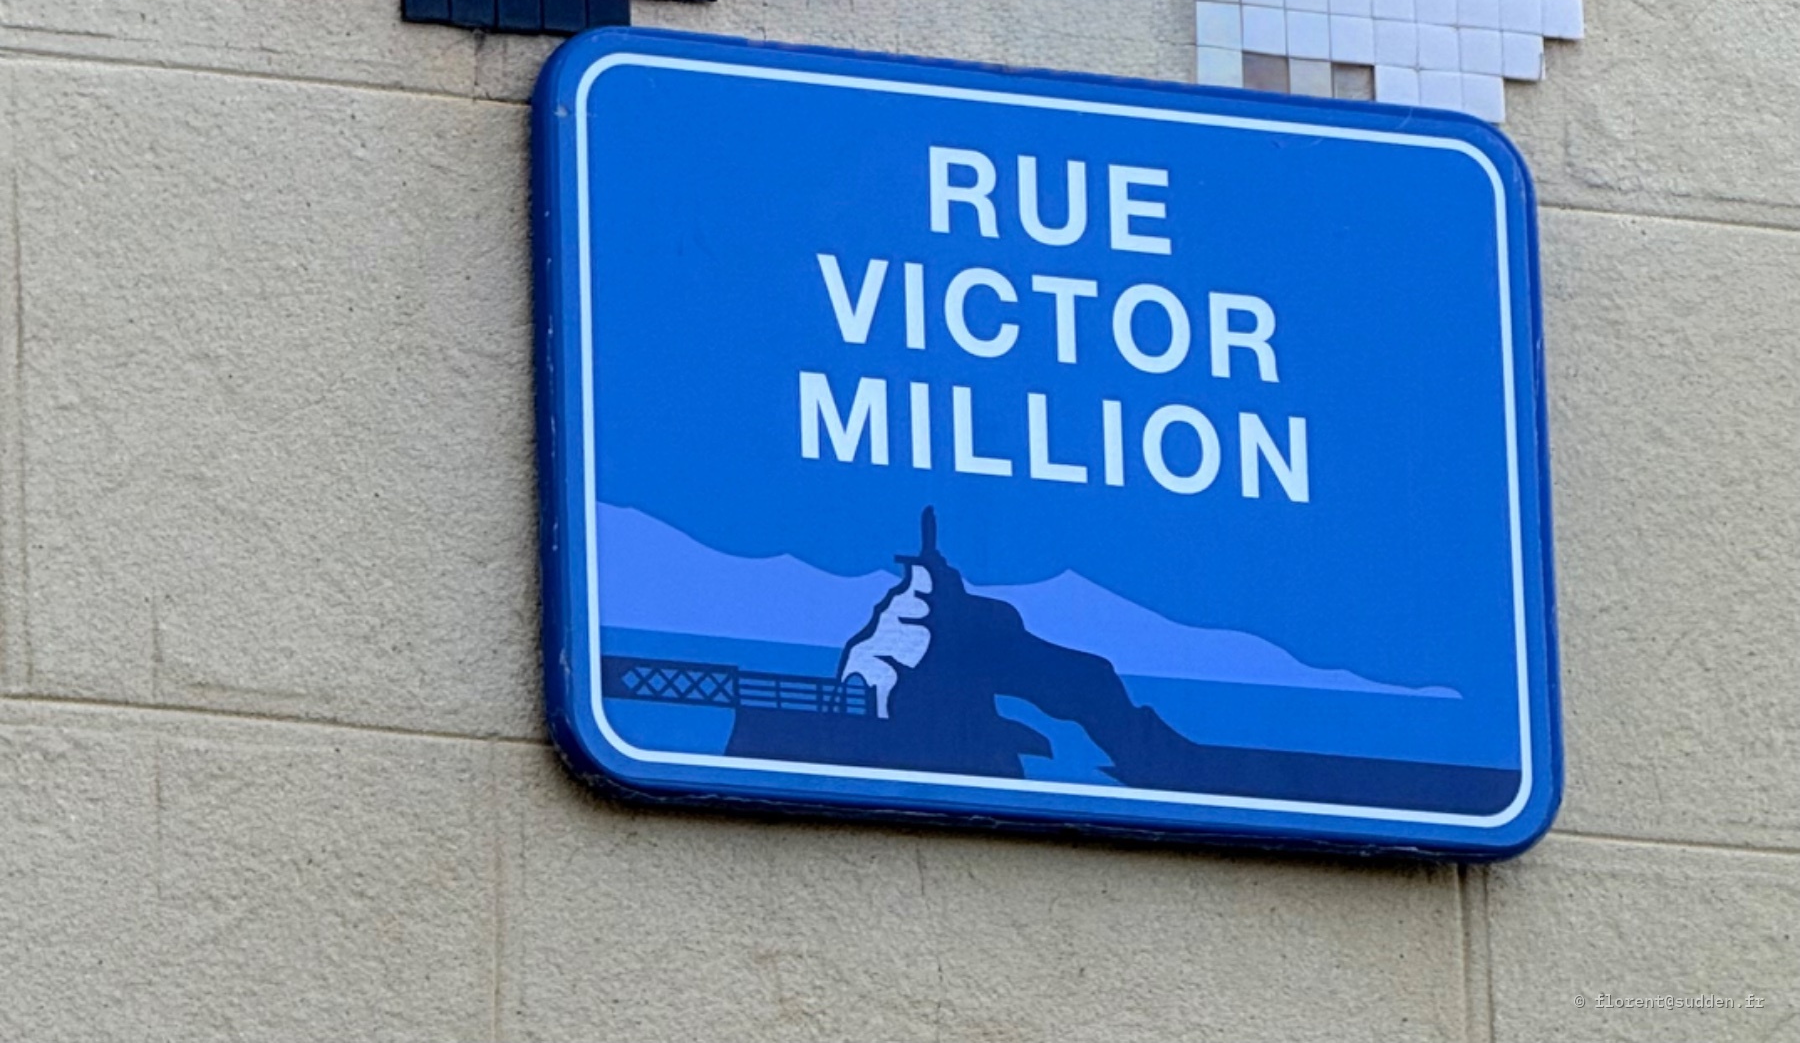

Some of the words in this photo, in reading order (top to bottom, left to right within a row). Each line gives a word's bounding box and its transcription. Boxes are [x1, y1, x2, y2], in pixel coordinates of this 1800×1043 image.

[928, 145, 1172, 256] RUE
[816, 253, 1280, 384] VICTOR
[798, 370, 1310, 504] MILLION
